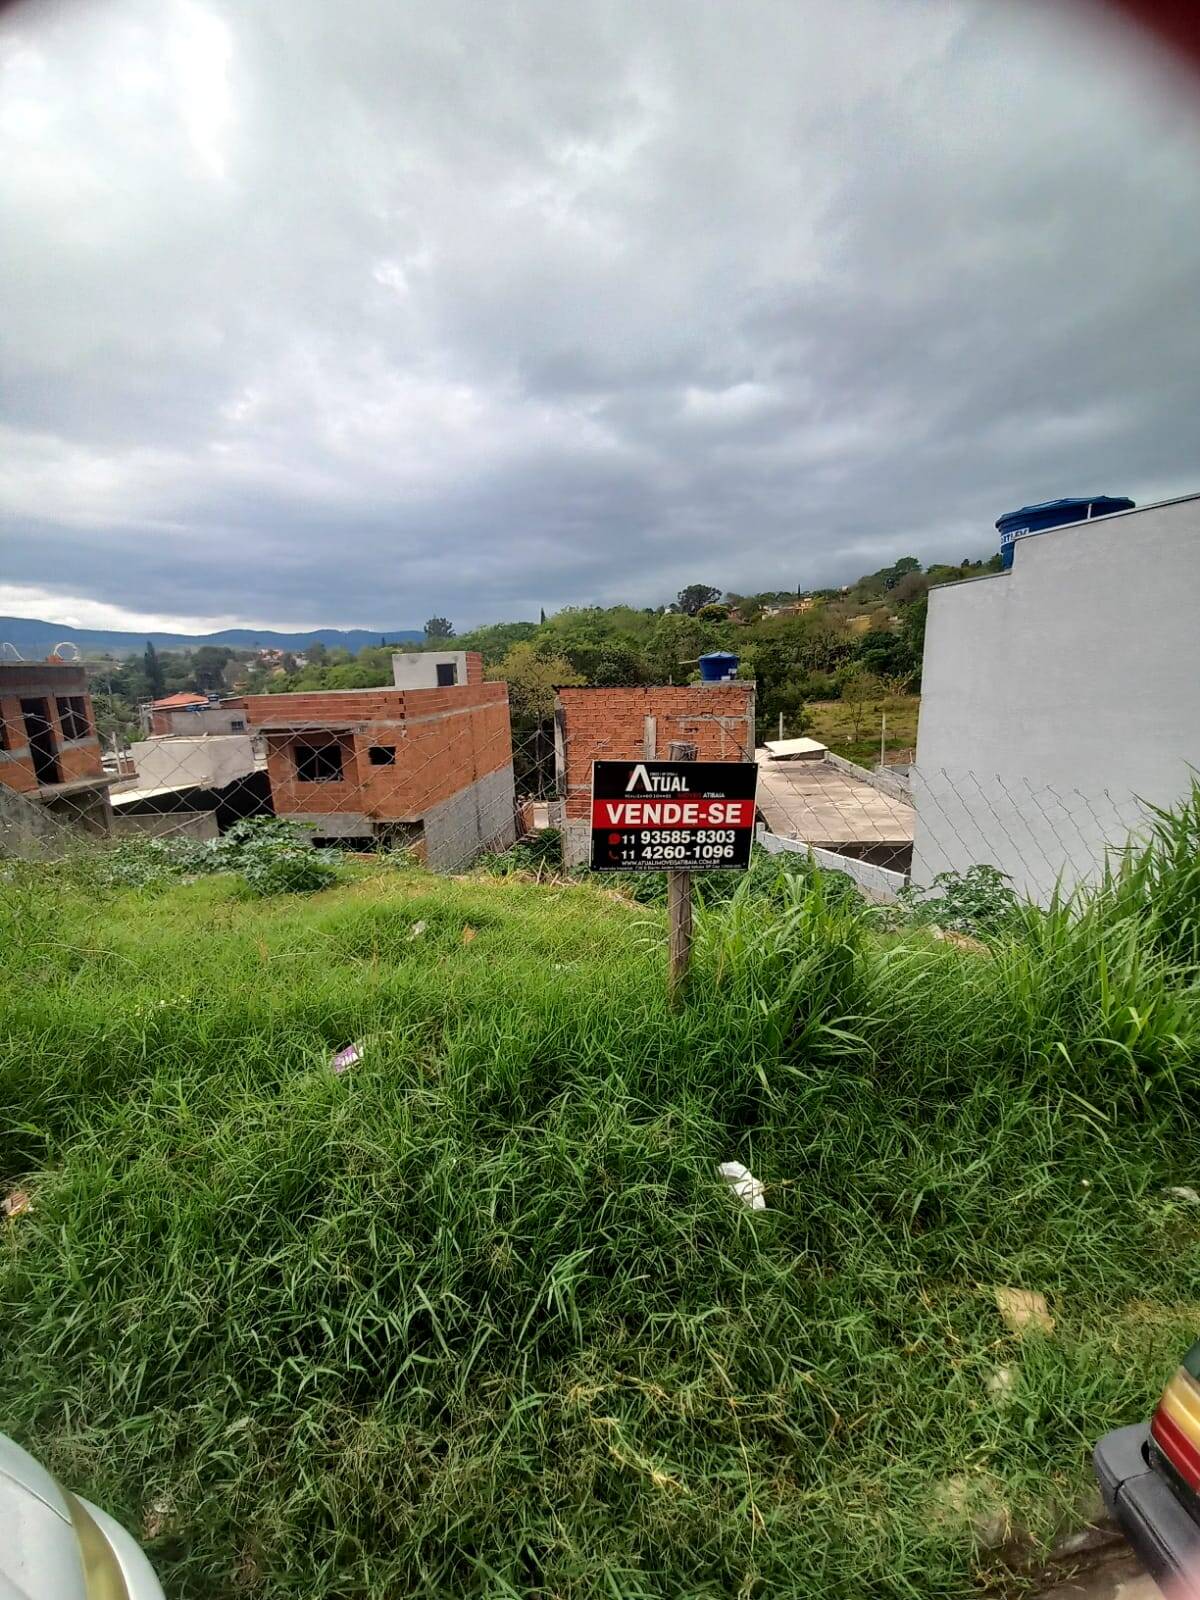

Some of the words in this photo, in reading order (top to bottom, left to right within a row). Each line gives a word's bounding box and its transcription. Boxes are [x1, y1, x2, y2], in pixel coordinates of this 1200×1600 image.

[625, 764, 690, 792] ATUAL
[606, 803, 742, 825] VENDE-SE
[622, 835, 635, 844] 11
[640, 830, 735, 844] 93585-8303
[621, 850, 635, 859] 11
[641, 845, 734, 859] 4260-1096
